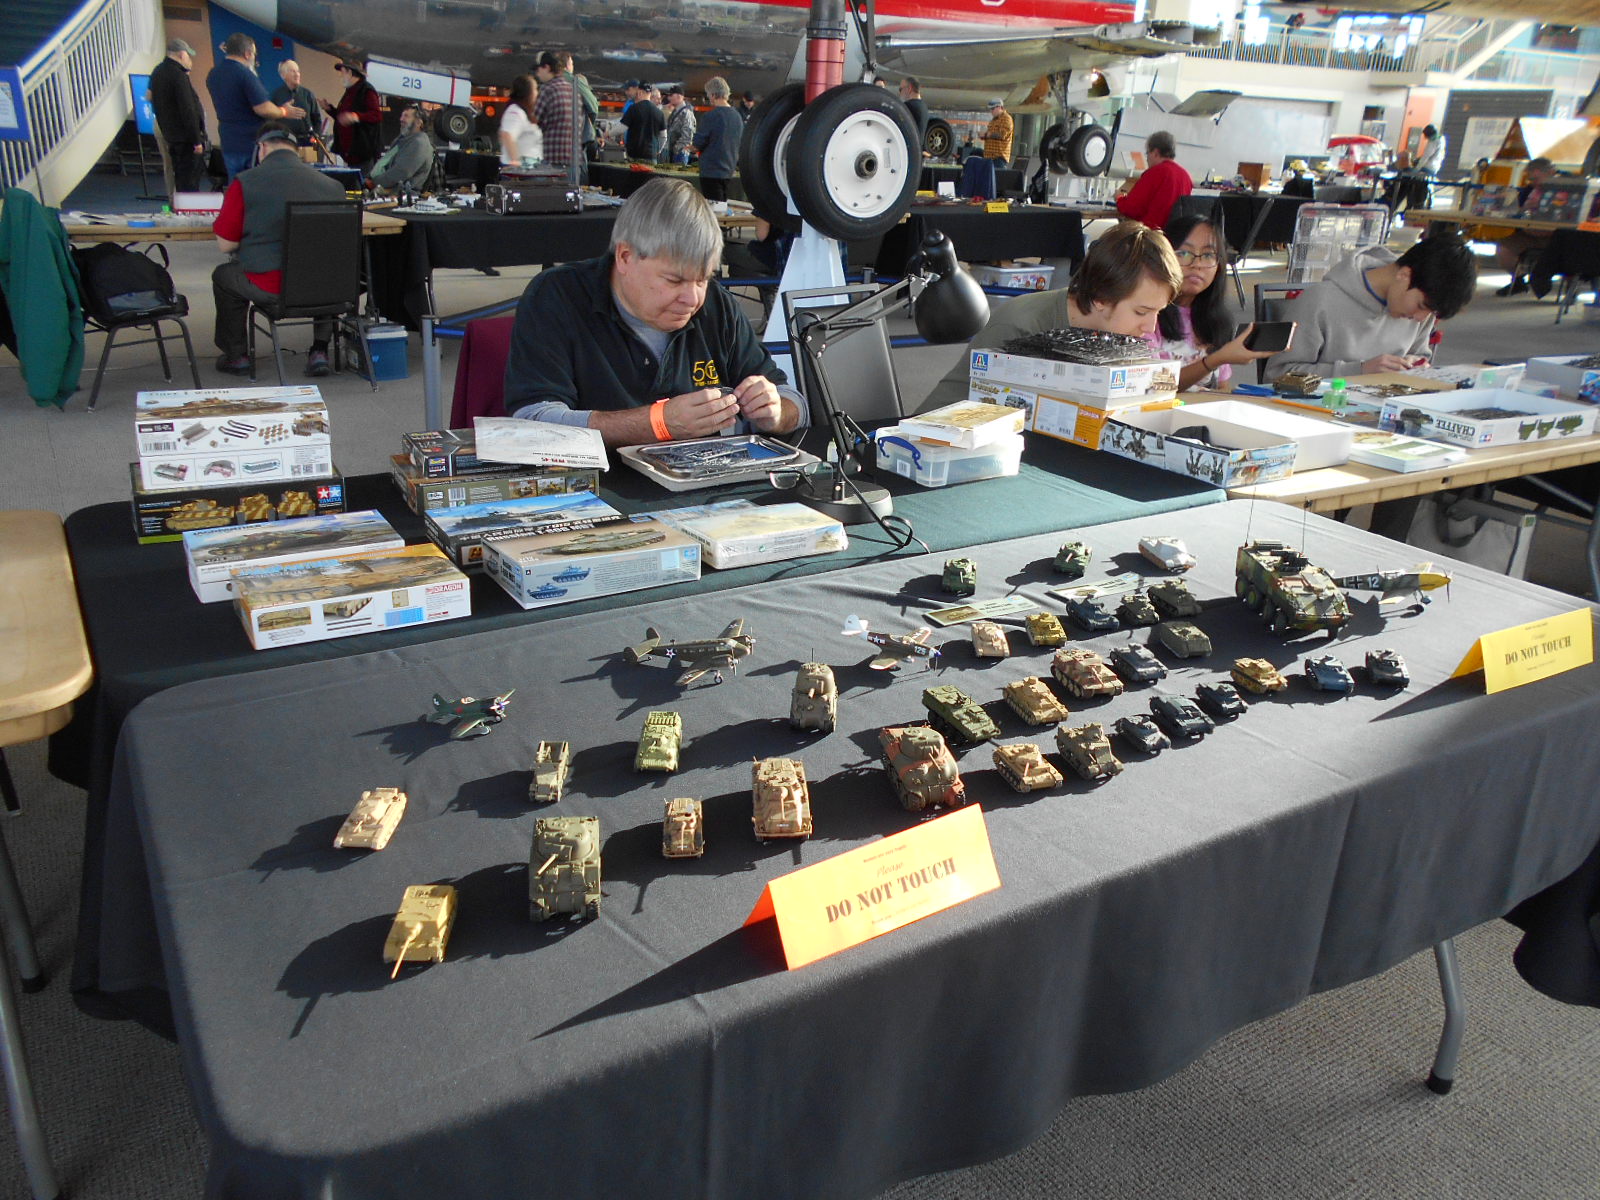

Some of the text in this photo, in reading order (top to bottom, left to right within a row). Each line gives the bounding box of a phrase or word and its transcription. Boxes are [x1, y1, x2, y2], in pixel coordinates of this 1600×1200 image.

[402, 77, 422, 89] 213
[1435, 419, 1476, 437] CHAFFEE
[433, 583, 464, 593] DRAGON
[1505, 651, 1518, 665] DO
[1520, 645, 1538, 661] NOT
[1542, 635, 1571, 654] TOUCH
[876, 862, 904, 877] Please
[825, 898, 852, 923] DO
[857, 881, 893, 911] NOT
[897, 857, 956, 893] TOUCH
